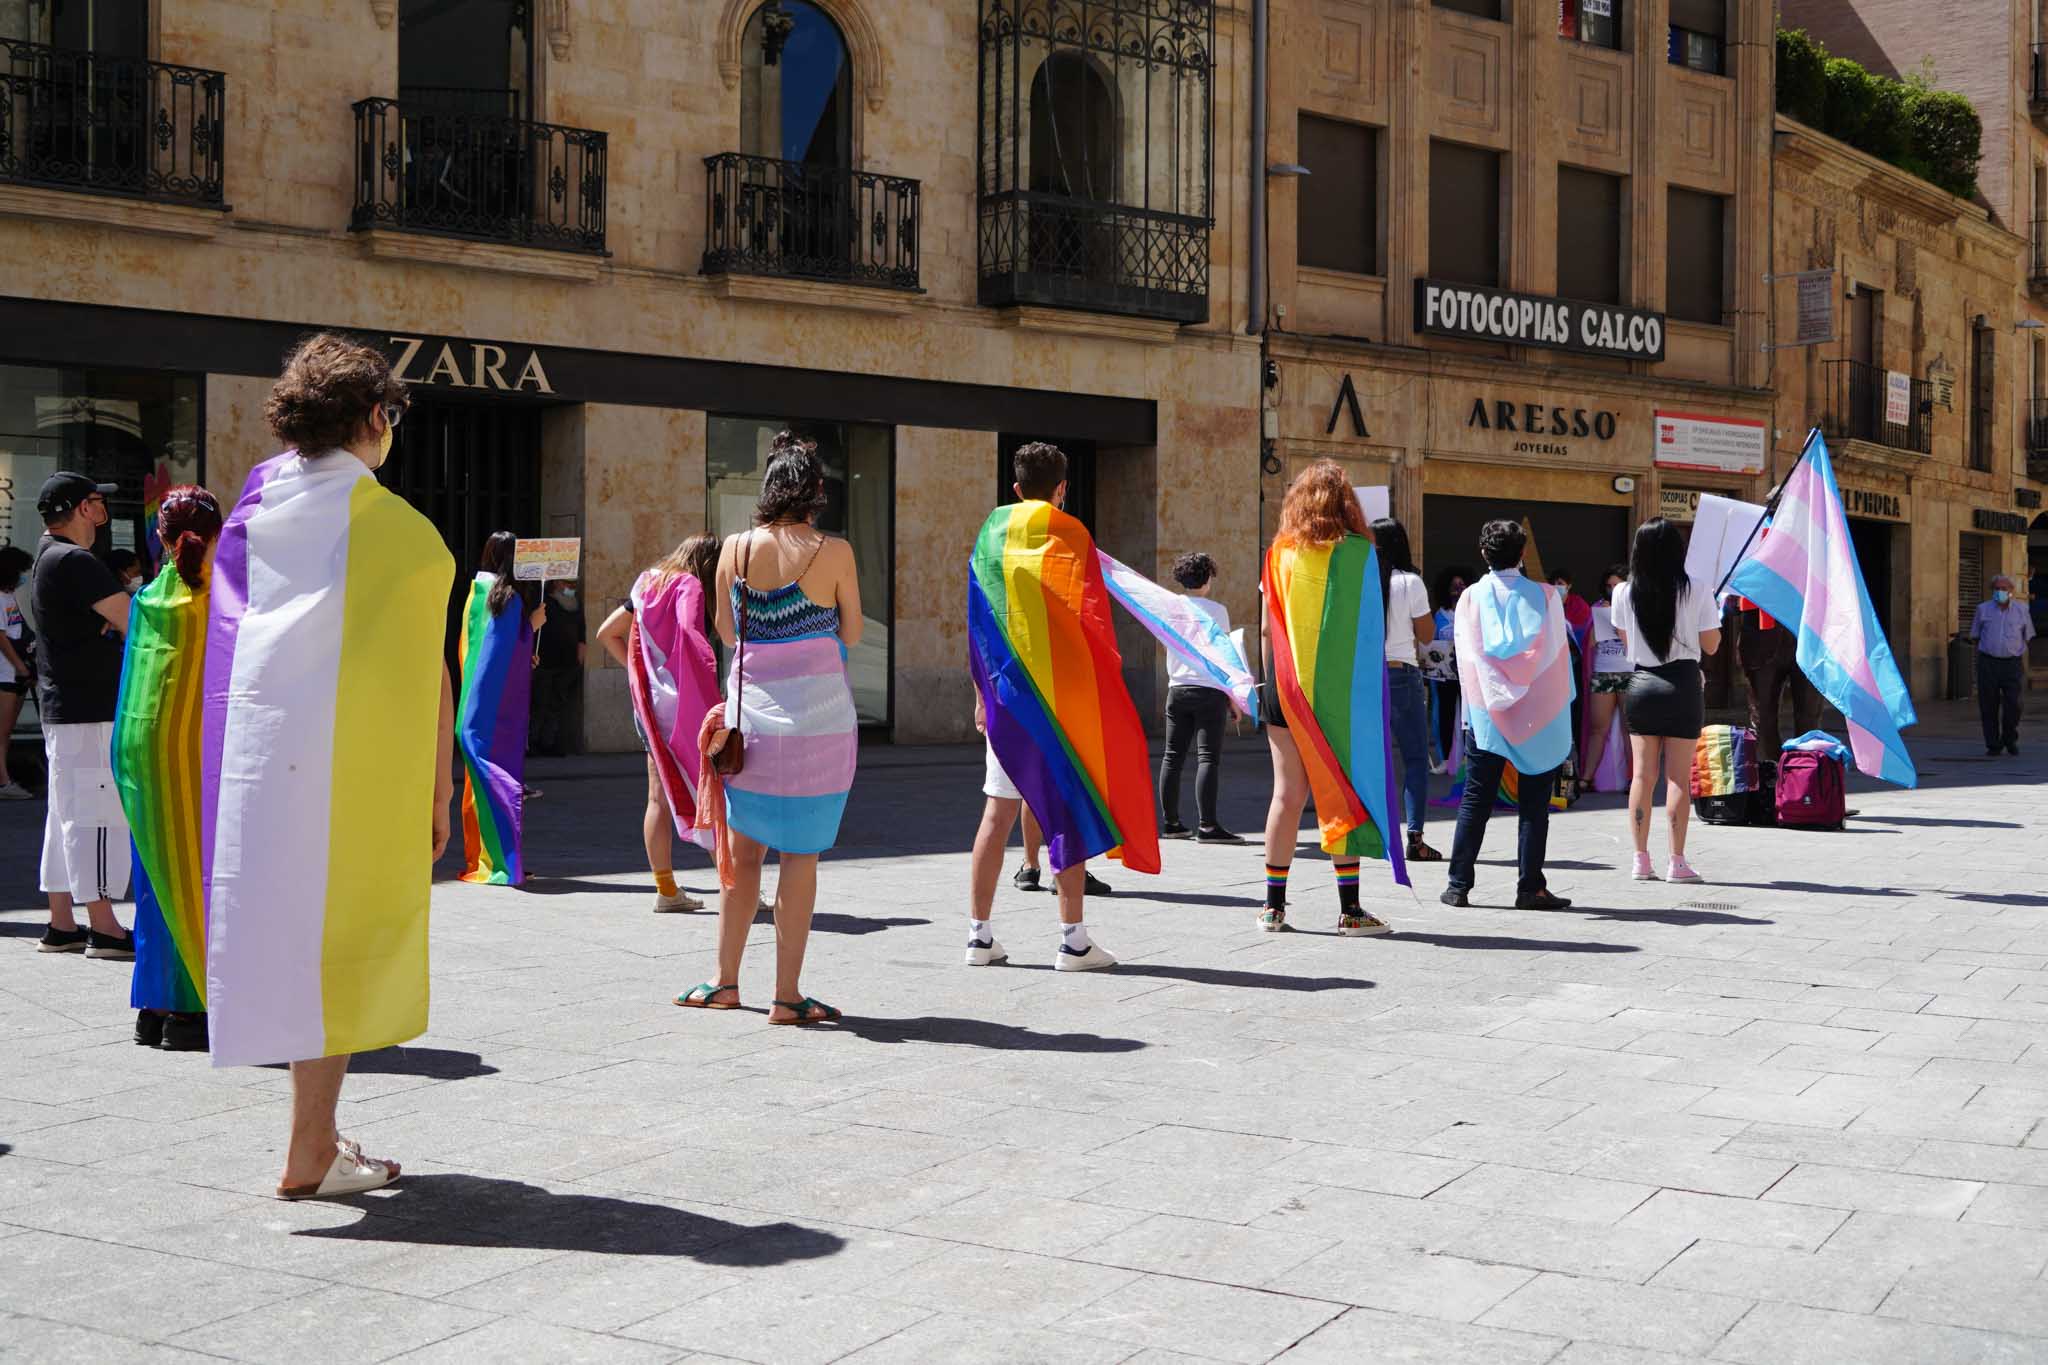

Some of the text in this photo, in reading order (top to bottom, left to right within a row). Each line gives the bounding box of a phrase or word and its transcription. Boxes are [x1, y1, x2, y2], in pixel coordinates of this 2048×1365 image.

[1426, 287, 1661, 354] FOTOCOPIAS CALCO
[390, 337, 556, 394] ZARA
[1468, 398, 1616, 440] ARESSO
[1514, 441, 1568, 455] JOYERÍAS
